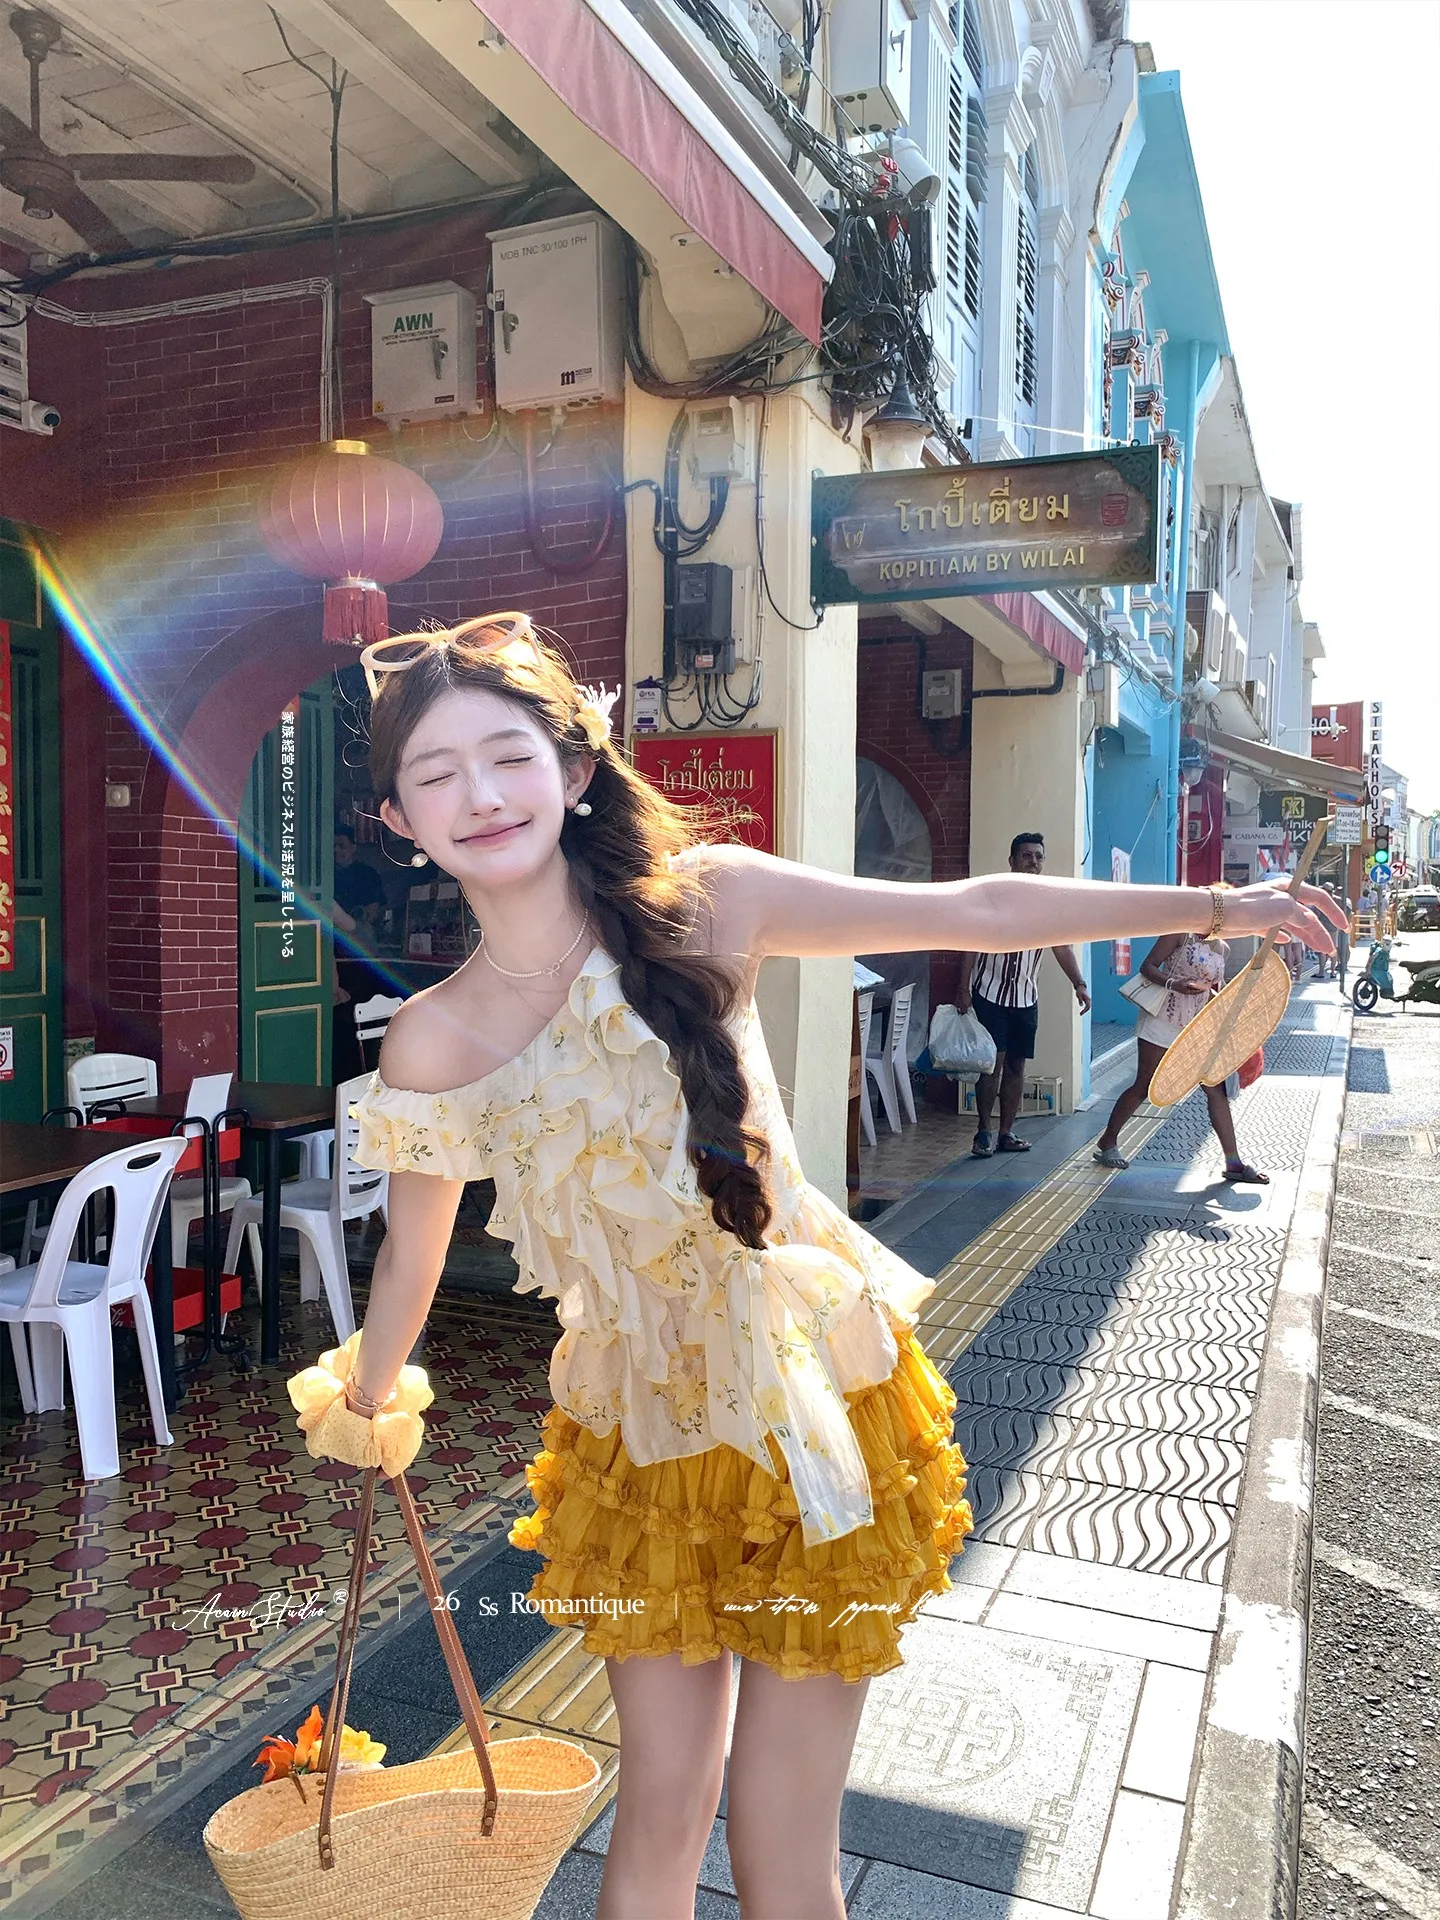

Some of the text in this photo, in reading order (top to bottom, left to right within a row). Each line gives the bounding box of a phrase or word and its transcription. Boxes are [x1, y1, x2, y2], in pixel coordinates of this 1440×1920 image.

[500, 248, 519, 261] MDB
[522, 245, 539, 257] TNC
[571, 235, 587, 247] 1PH
[393, 312, 433, 333] AWN
[894, 477, 1070, 533] โกปี้เตี่ยม
[879, 545, 1085, 581] KOPITIAM BY WILAI
